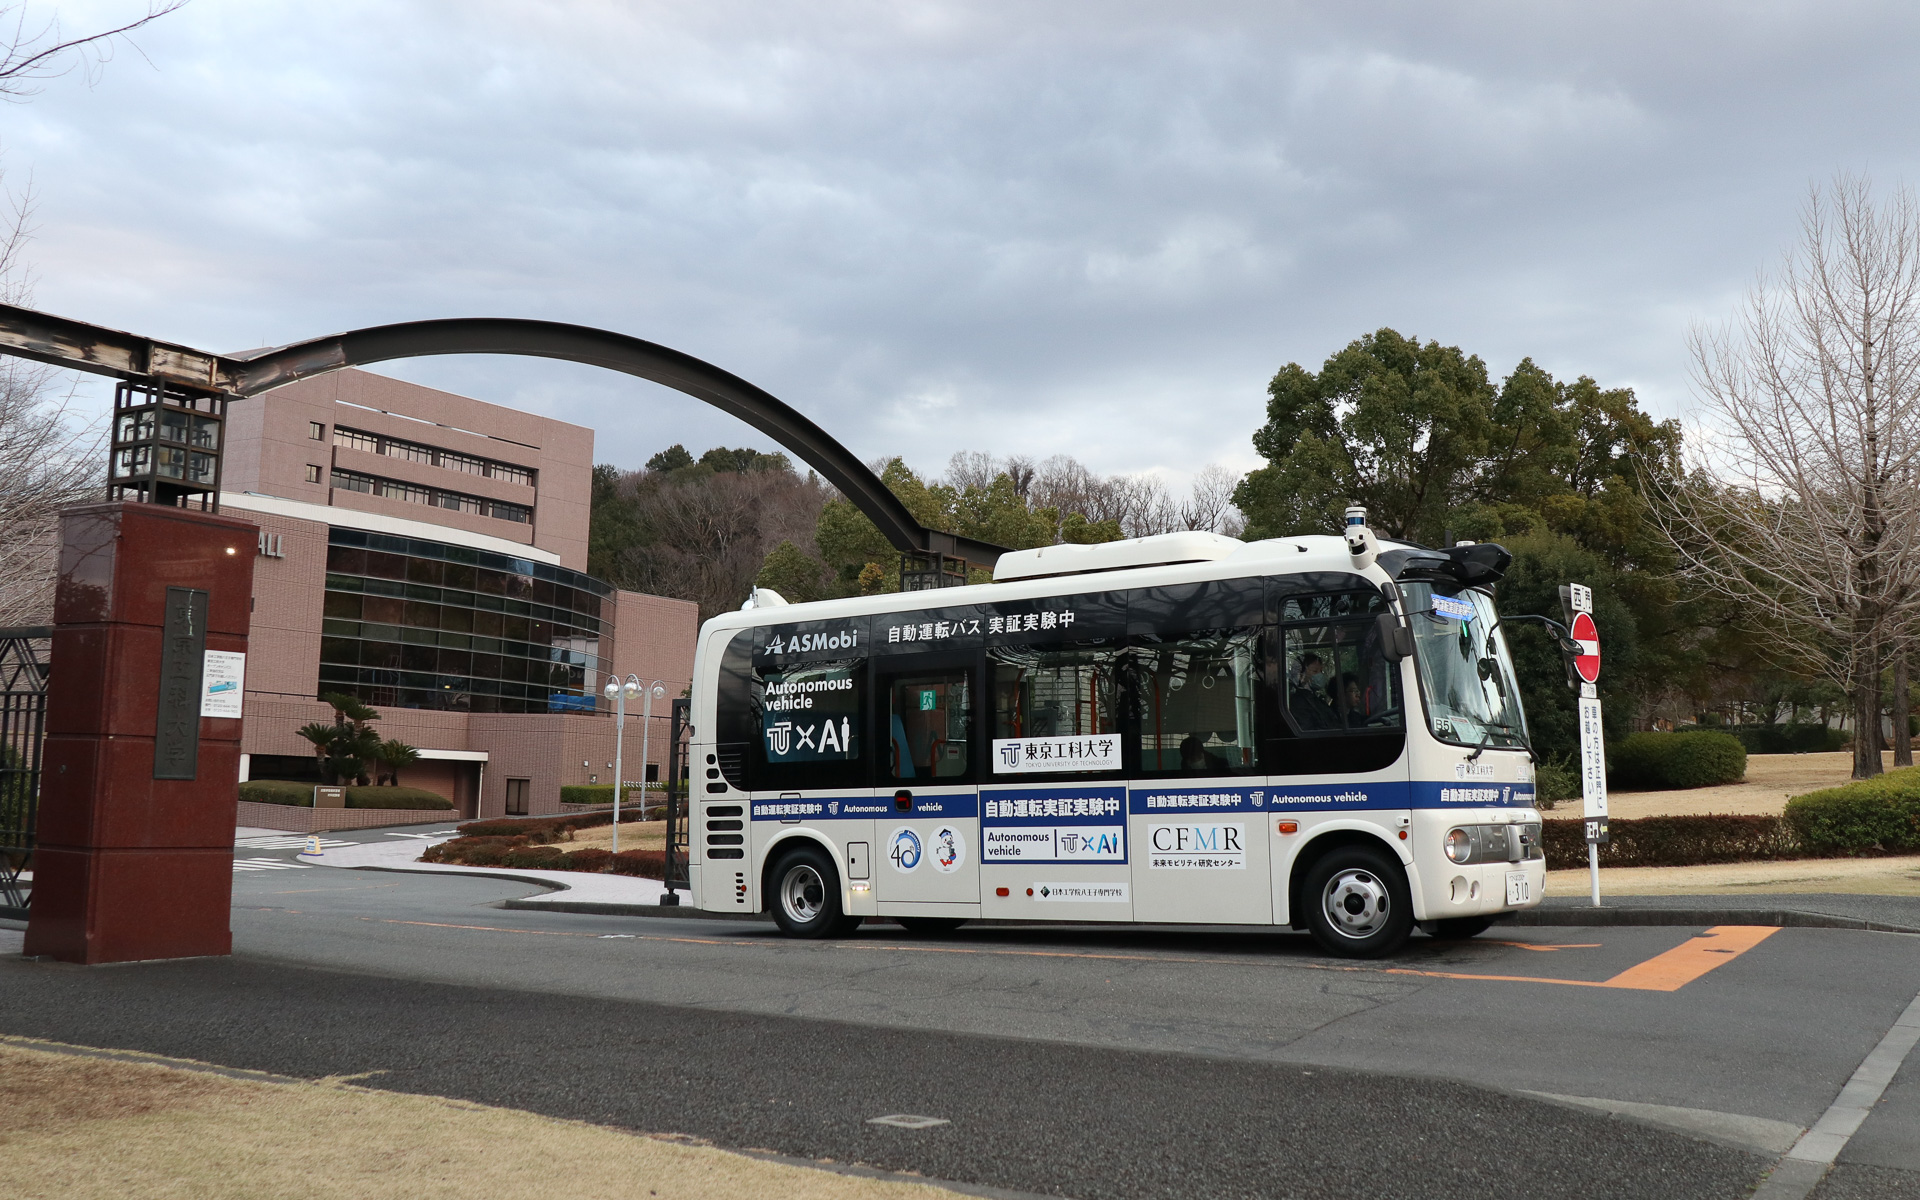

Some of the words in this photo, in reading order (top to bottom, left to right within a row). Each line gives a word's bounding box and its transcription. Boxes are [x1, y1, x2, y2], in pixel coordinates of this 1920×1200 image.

[888, 618, 981, 644] 自動運転バス
[988, 609, 1076, 635] 実証実験中
[787, 629, 858, 653] ASMobi
[765, 678, 853, 696] Autonomous
[765, 694, 813, 711] vehicle
[1025, 739, 1113, 760] 東京工科大学
[1080, 759, 1113, 767] TECHNOLOGY
[1146, 793, 1242, 808] 自動運転実証実験中
[1271, 793, 1332, 804] Autonomous
[1334, 791, 1368, 802] vehicle
[1440, 788, 1500, 802] 自動運転実証実験中
[753, 802, 823, 816] 自動運転実証実験中
[843, 804, 888, 813] Autonomous
[917, 802, 943, 812] vehicle
[985, 797, 1120, 818] 自動運転実証実験中
[987, 832, 1050, 842] Autonomous
[1152, 827, 1243, 851] CFMR
[988, 845, 1021, 856] vehicle
[1152, 858, 1241, 867] 未来モビリティ研究センター
[1052, 888, 1122, 897] 日本工学院八王子専門学校
